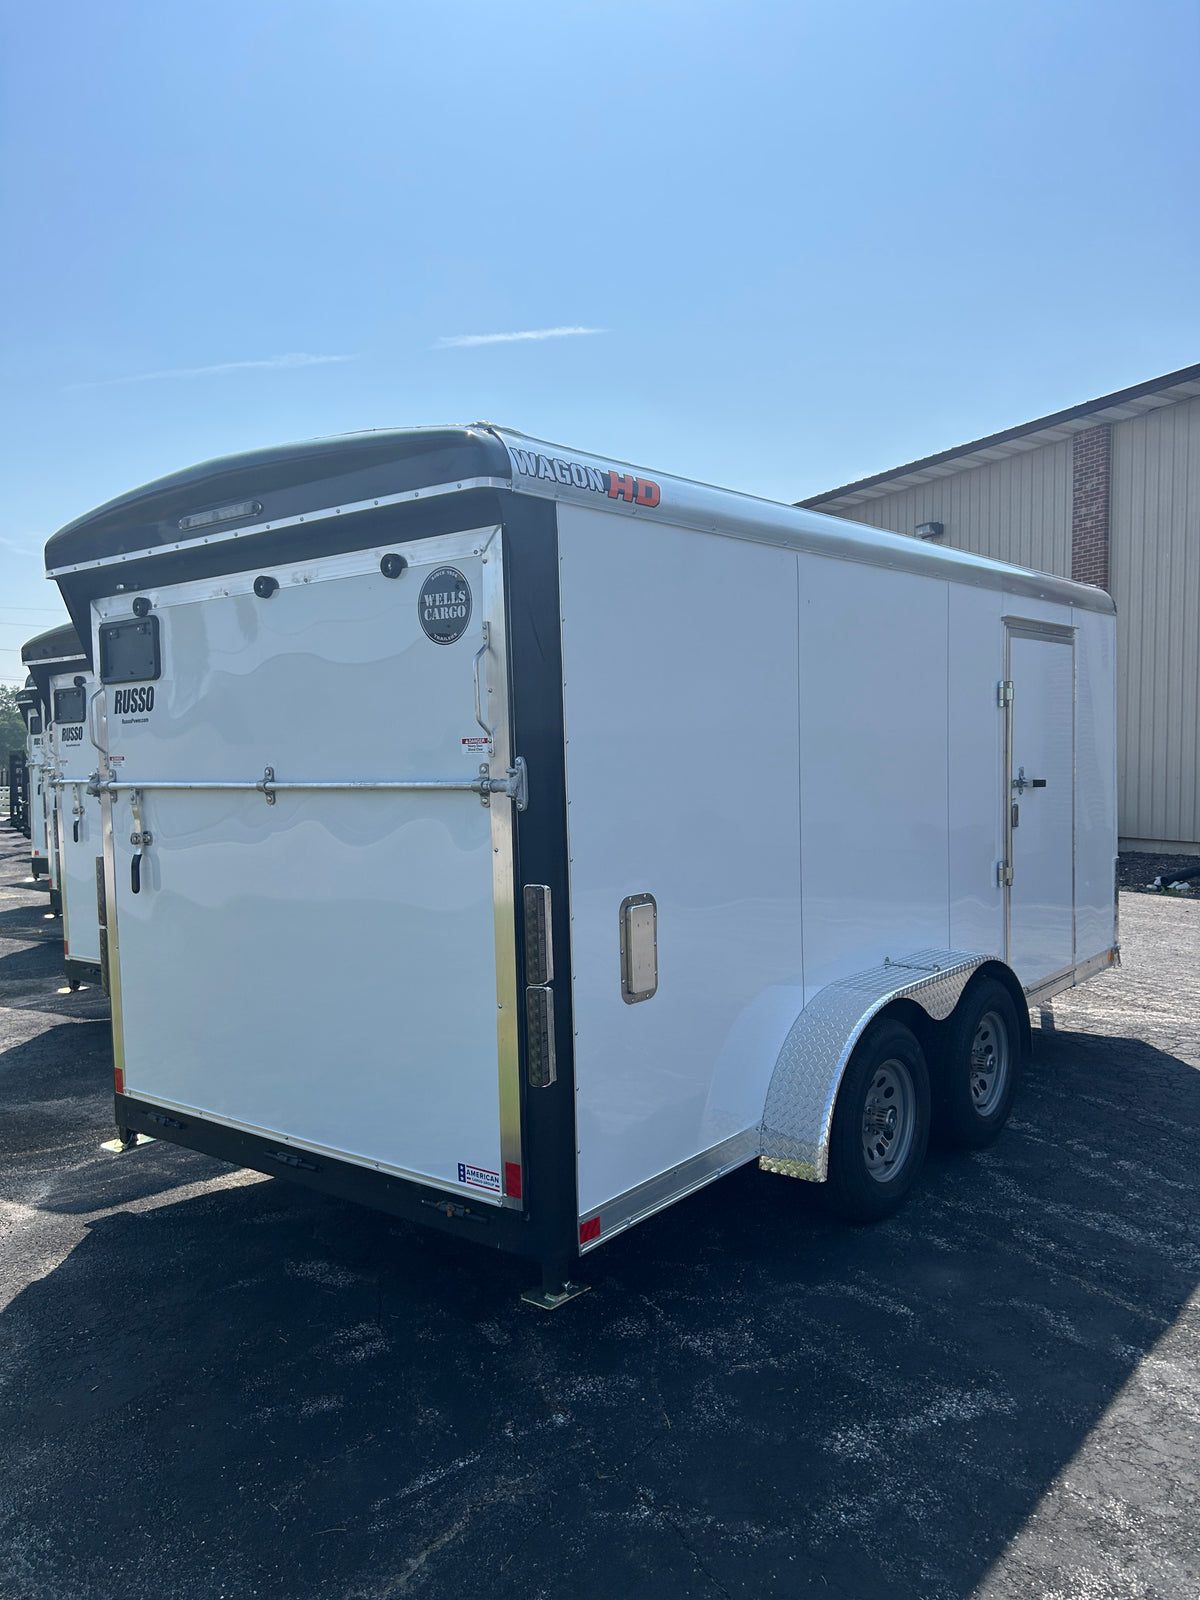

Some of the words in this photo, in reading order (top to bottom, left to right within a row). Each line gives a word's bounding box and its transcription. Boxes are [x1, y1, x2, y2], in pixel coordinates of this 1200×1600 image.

[509, 447, 606, 493] WAGON
[608, 470, 661, 508] HD
[424, 590, 466, 607] WELLS
[424, 605, 466, 621] CARGO
[434, 633, 458, 641] TRAILERS
[114, 686, 154, 714] RUSSO
[62, 726, 83, 742] RUSSO
[466, 1169, 499, 1183] AMERICAN
